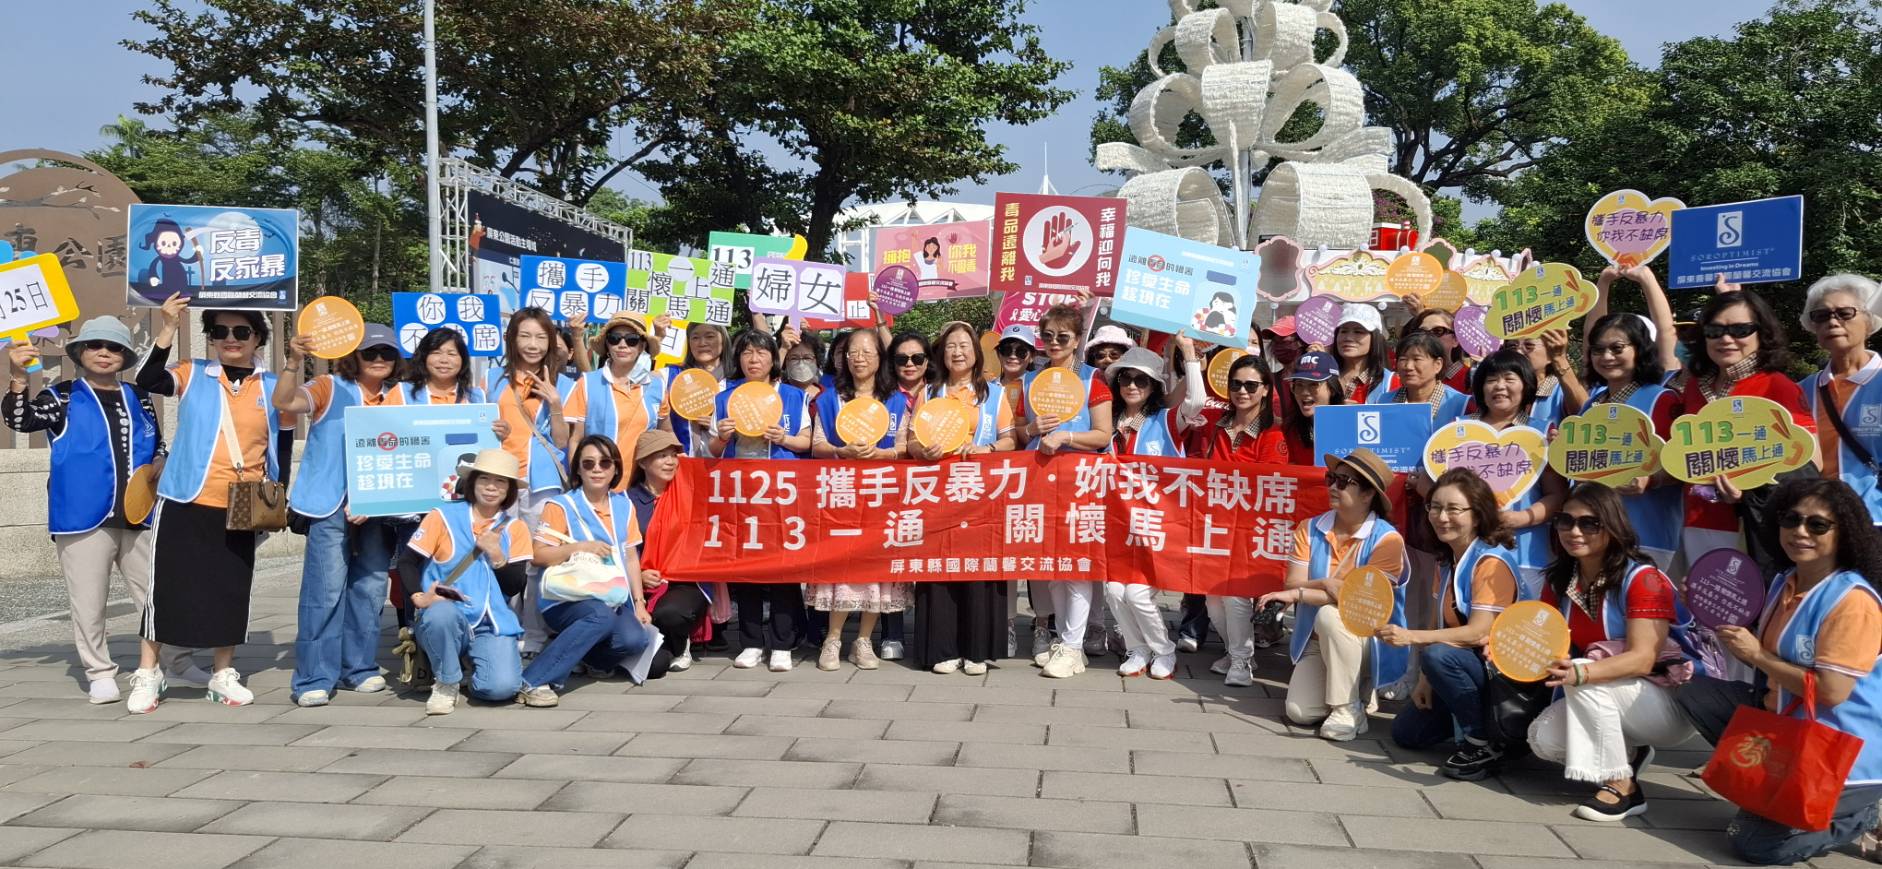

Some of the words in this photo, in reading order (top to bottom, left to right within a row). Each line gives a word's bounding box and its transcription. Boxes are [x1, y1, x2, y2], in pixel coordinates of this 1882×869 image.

[210, 228, 261, 254] 反毒
[948, 243, 977, 259] 你我
[1000, 203, 1020, 282] 毒品遠離我
[1096, 207, 1116, 288] 幸福迎向我
[210, 254, 285, 282] 反家暴
[714, 248, 752, 270] 113
[539, 262, 605, 290] 攜手
[1126, 269, 1191, 296] 珍愛生命
[0, 281, 48, 319] 25日
[530, 291, 620, 316] 反暴力
[756, 267, 841, 314] 婦女
[419, 294, 484, 321] 你我
[401, 325, 498, 350] 不席
[356, 453, 432, 471] 珍愛生命
[1431, 441, 1520, 464] 攜手反暴力
[1566, 449, 1643, 474] 關懷馬上通
[1685, 443, 1784, 478] 關懷馬上通
[357, 473, 415, 491] 趁現在
[708, 470, 798, 505] 1125
